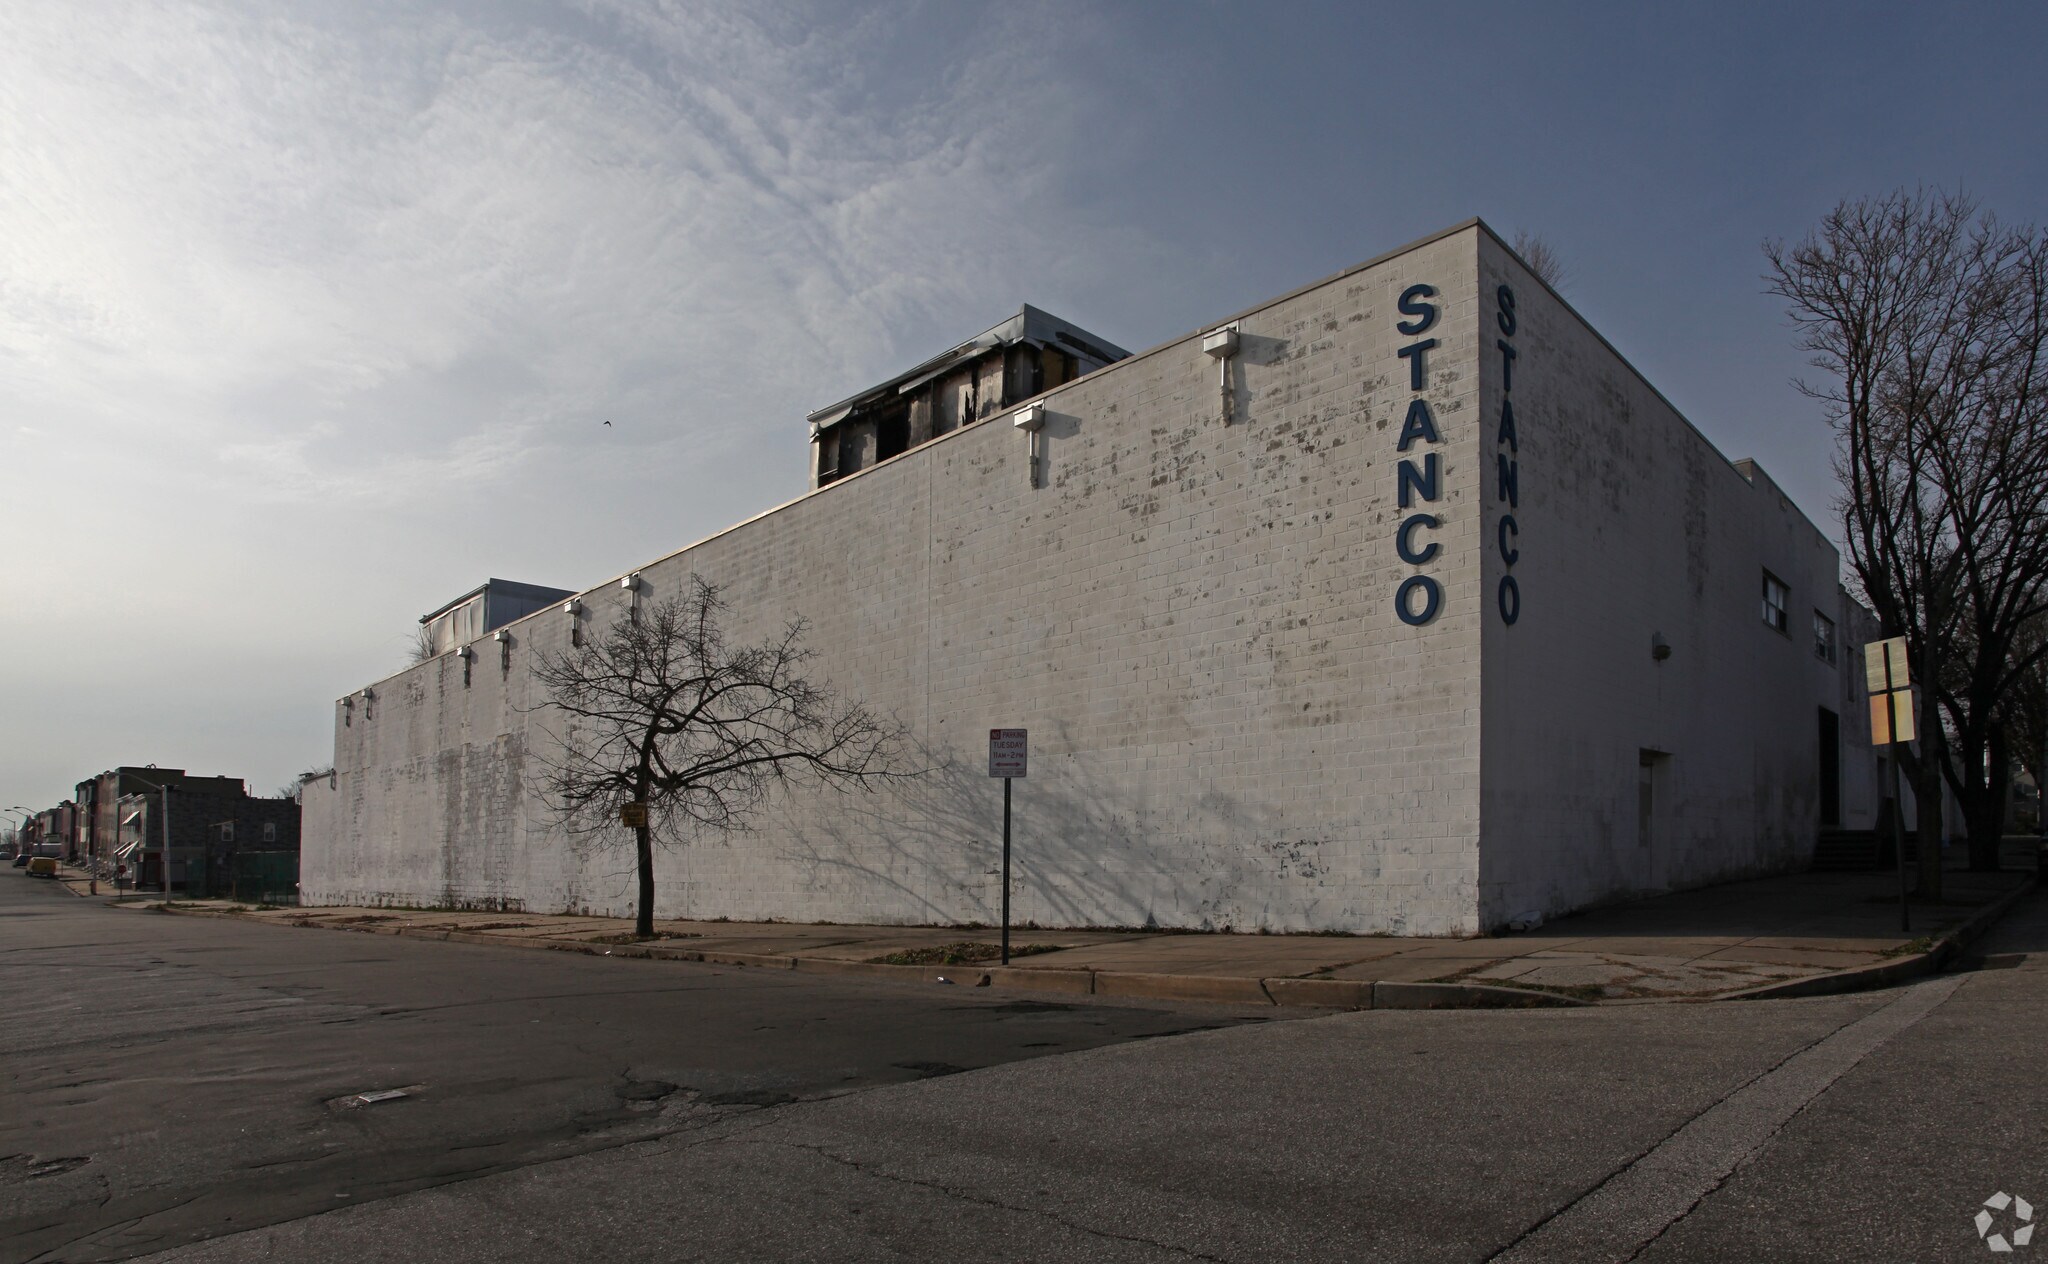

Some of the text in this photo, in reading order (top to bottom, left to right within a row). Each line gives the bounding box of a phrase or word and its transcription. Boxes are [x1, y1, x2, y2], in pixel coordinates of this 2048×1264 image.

[1395, 283, 1439, 626] STANCO
[1496, 284, 1520, 626] STANCO
[992, 731, 1025, 739] NO PARKING
[993, 741, 1024, 749] TUESDAY
